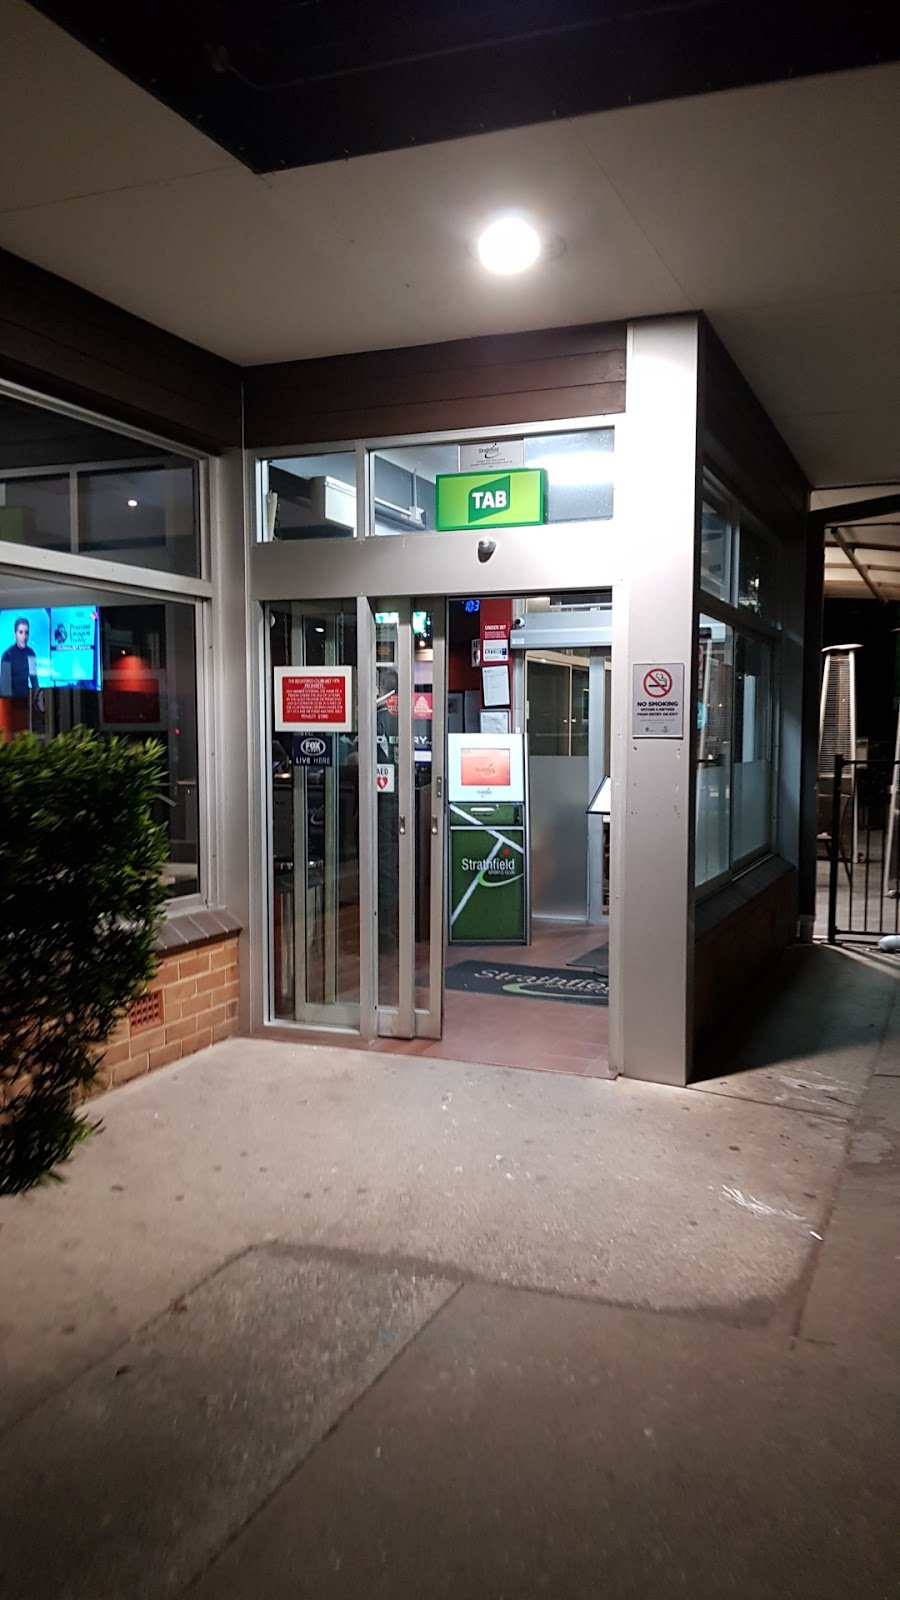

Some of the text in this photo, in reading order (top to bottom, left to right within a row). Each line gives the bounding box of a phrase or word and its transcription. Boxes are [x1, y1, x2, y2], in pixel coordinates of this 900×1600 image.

[472, 491, 507, 509] TAB
[306, 741, 320, 750] FOX
[462, 858, 515, 870] Strathfield
